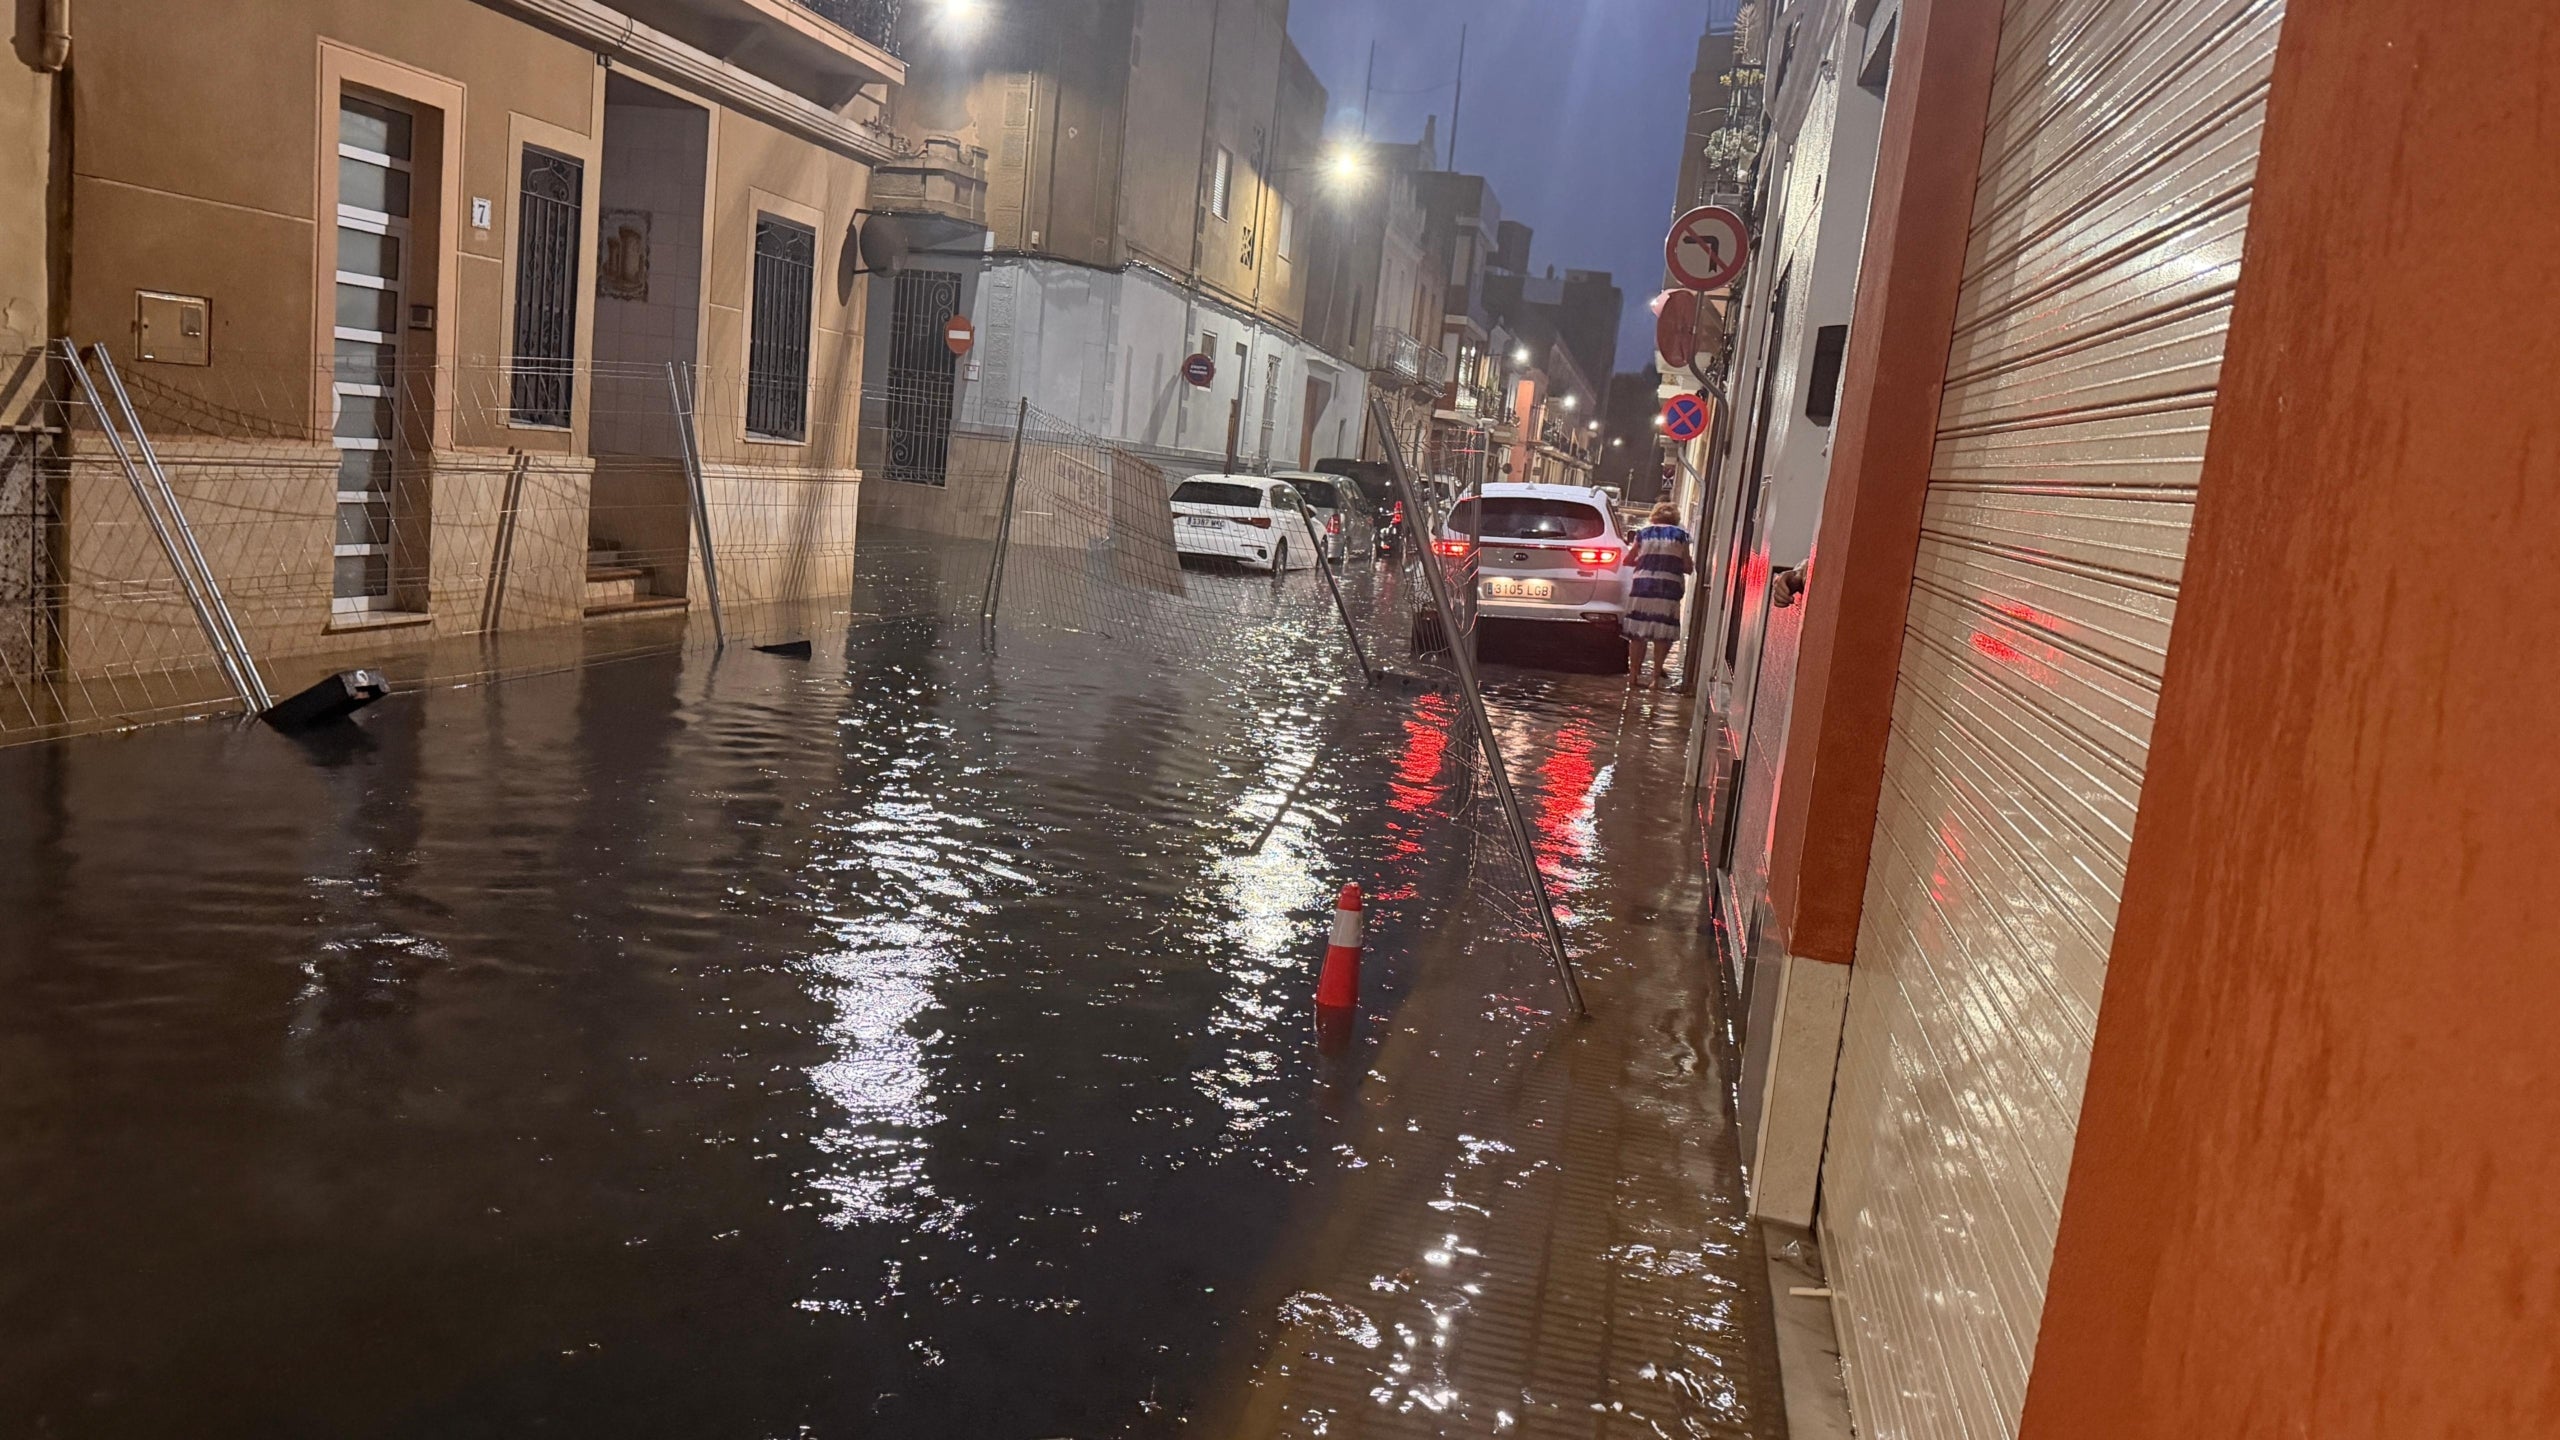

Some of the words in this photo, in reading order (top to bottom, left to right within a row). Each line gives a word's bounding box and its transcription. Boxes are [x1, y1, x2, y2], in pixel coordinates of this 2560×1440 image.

[478, 203, 486, 224] 7
[1495, 584, 1524, 596] 3105
[1527, 586, 1549, 597] LGB
